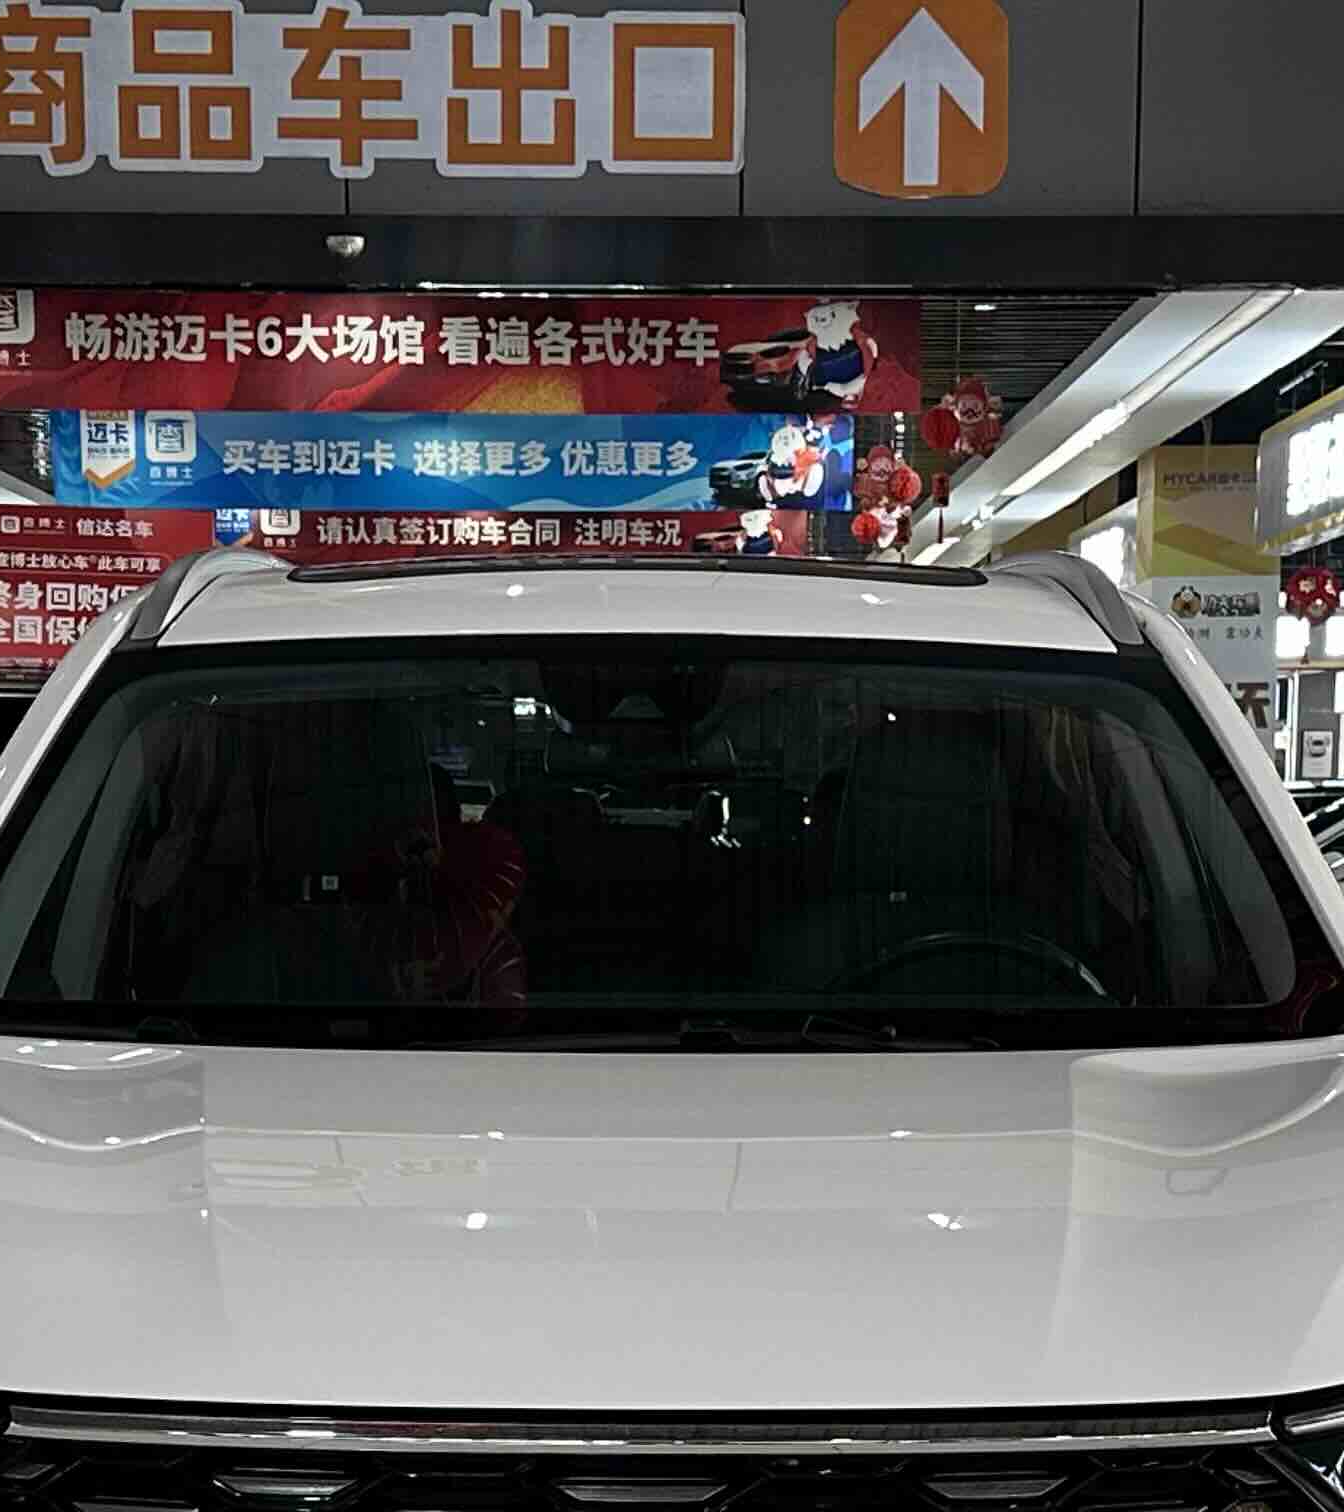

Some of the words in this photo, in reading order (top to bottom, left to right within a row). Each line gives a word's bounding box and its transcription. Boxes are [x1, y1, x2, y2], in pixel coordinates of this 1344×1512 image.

[65, 313, 426, 366] 畅游迈卡6大场馆
[438, 315, 720, 368] 看遍各式好车
[87, 421, 129, 445] 迈卡
[223, 439, 395, 475] 买车到迈卡
[413, 440, 551, 477] 选择更多
[560, 440, 699, 477] 优惠更多
[76, 517, 154, 538] 信达名车
[317, 516, 561, 547] 请认真签订购车合同
[575, 517, 682, 547] 注明车况
